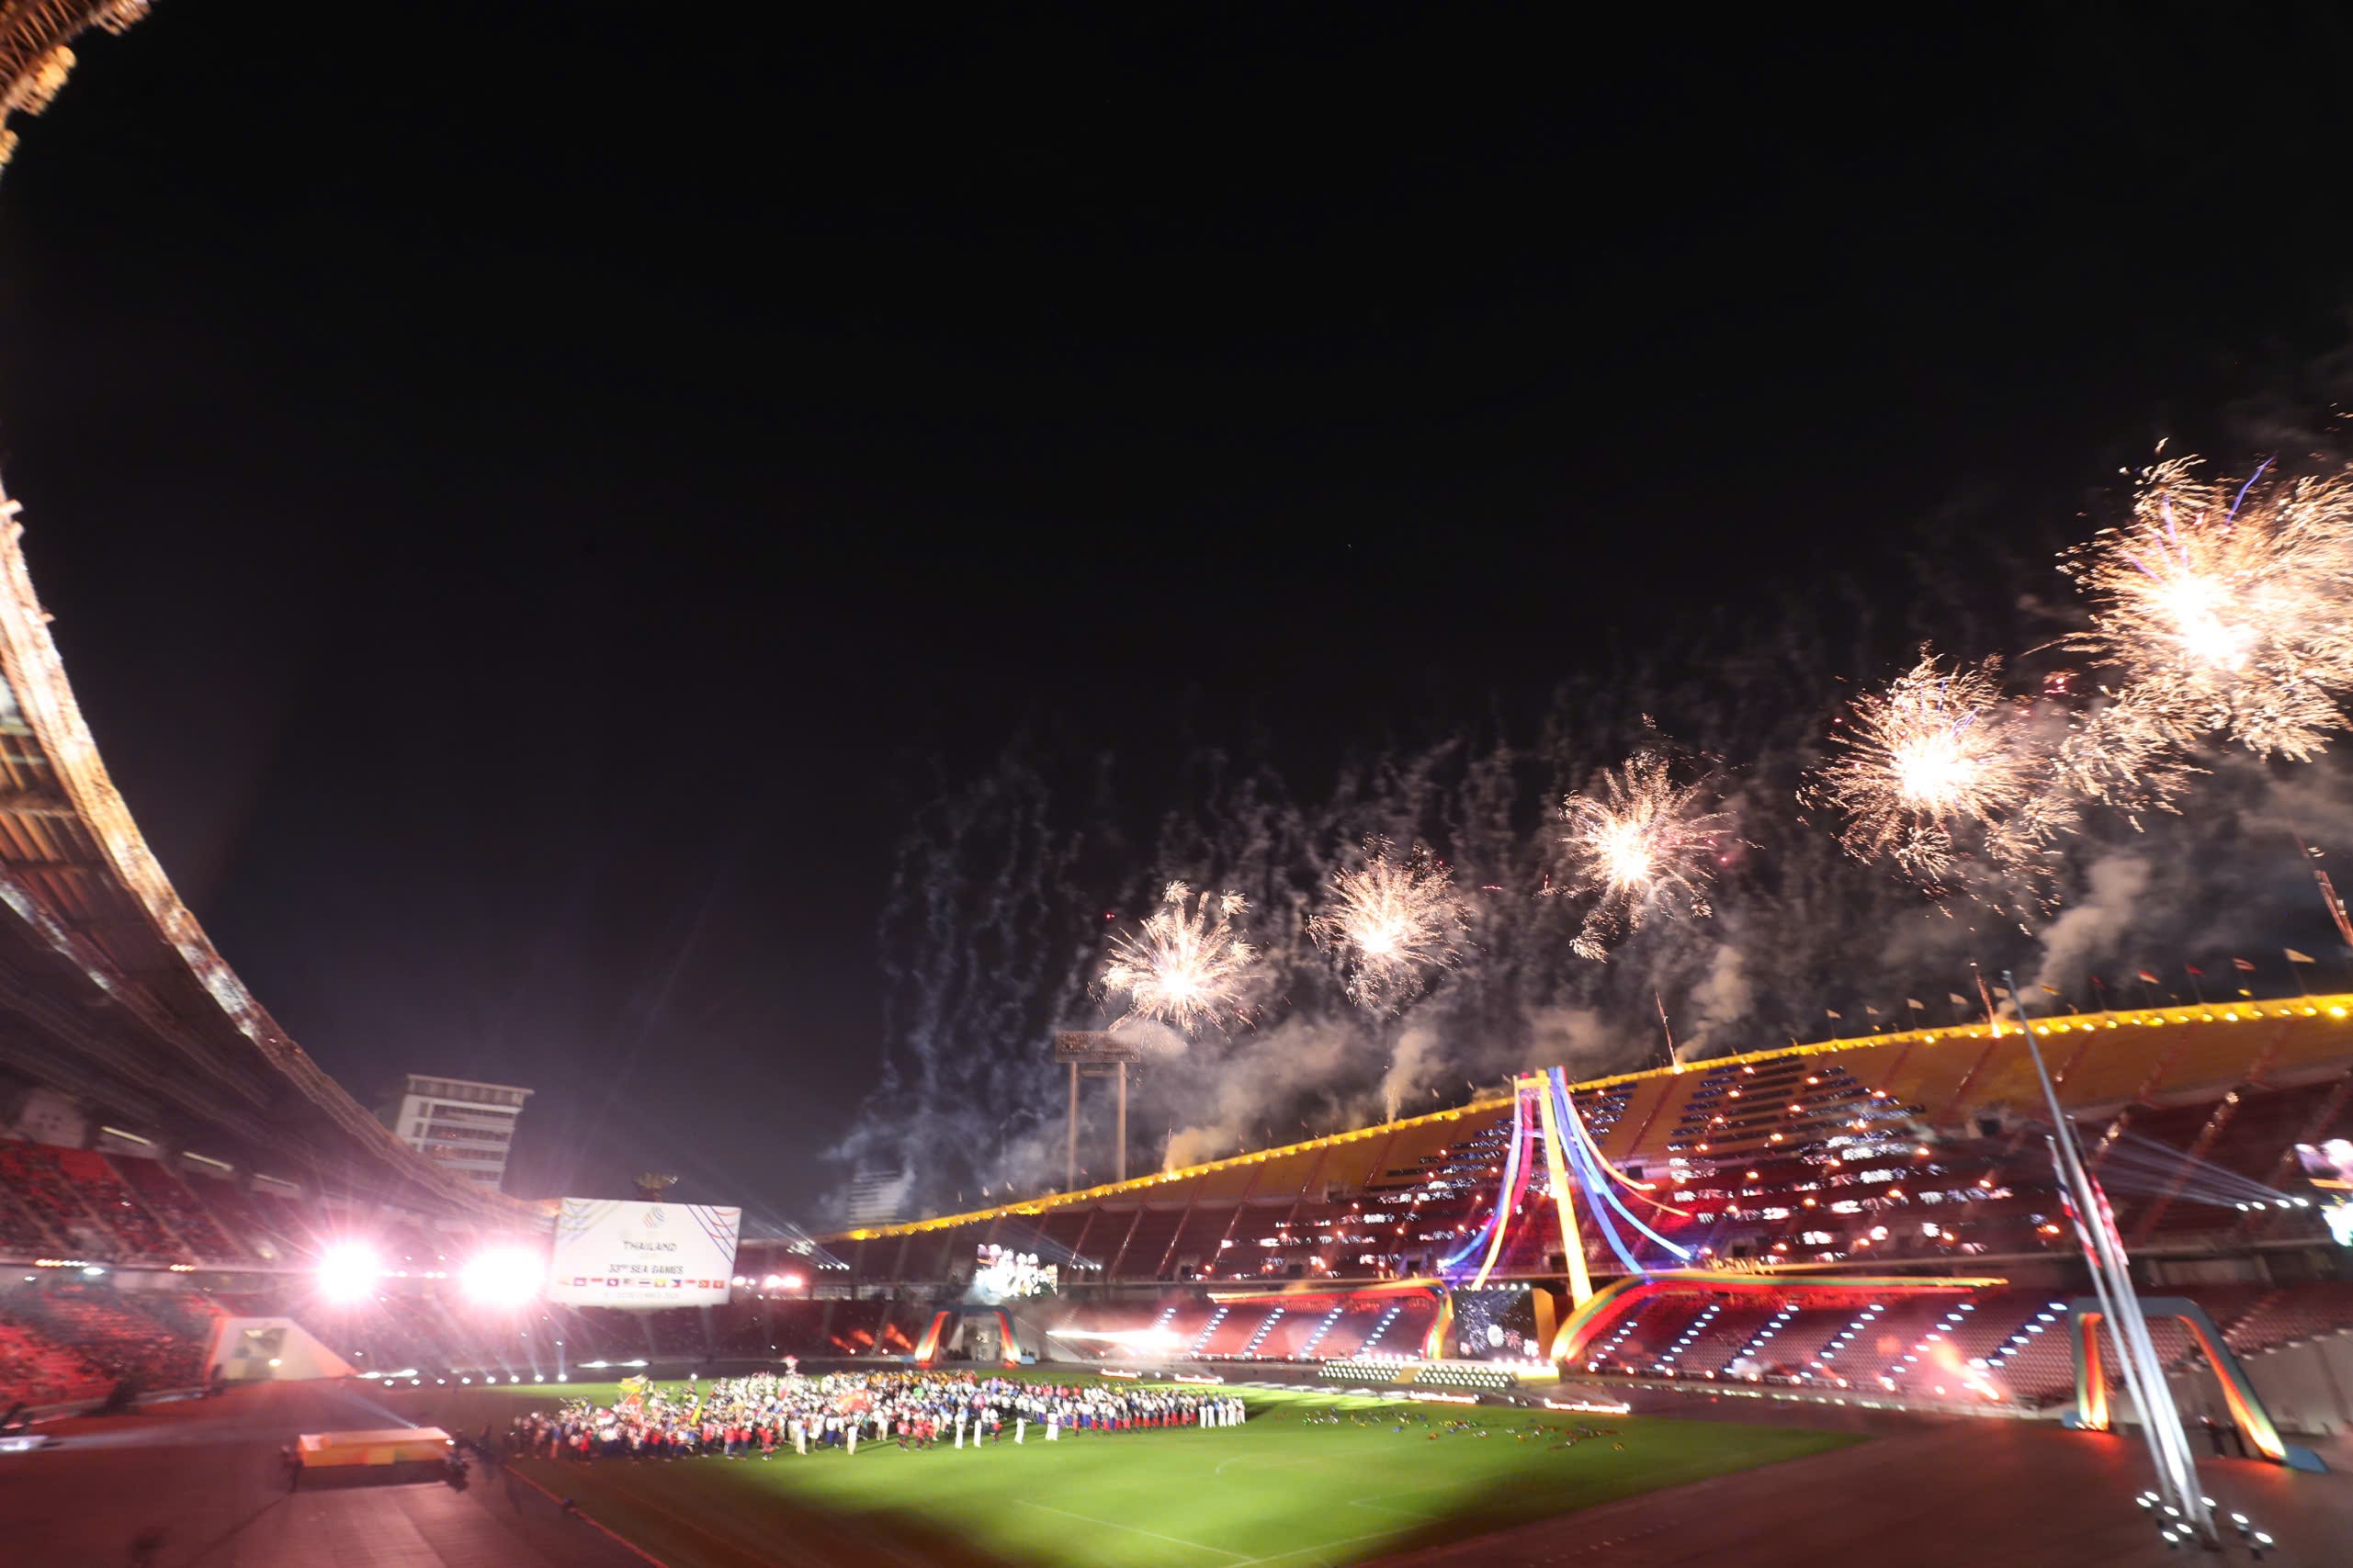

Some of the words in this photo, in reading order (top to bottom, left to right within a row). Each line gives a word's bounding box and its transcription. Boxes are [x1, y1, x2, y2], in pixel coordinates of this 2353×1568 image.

[624, 1241, 677, 1251] THAILAND
[630, 1264, 648, 1274] SEA
[651, 1265, 684, 1275] GAMES
